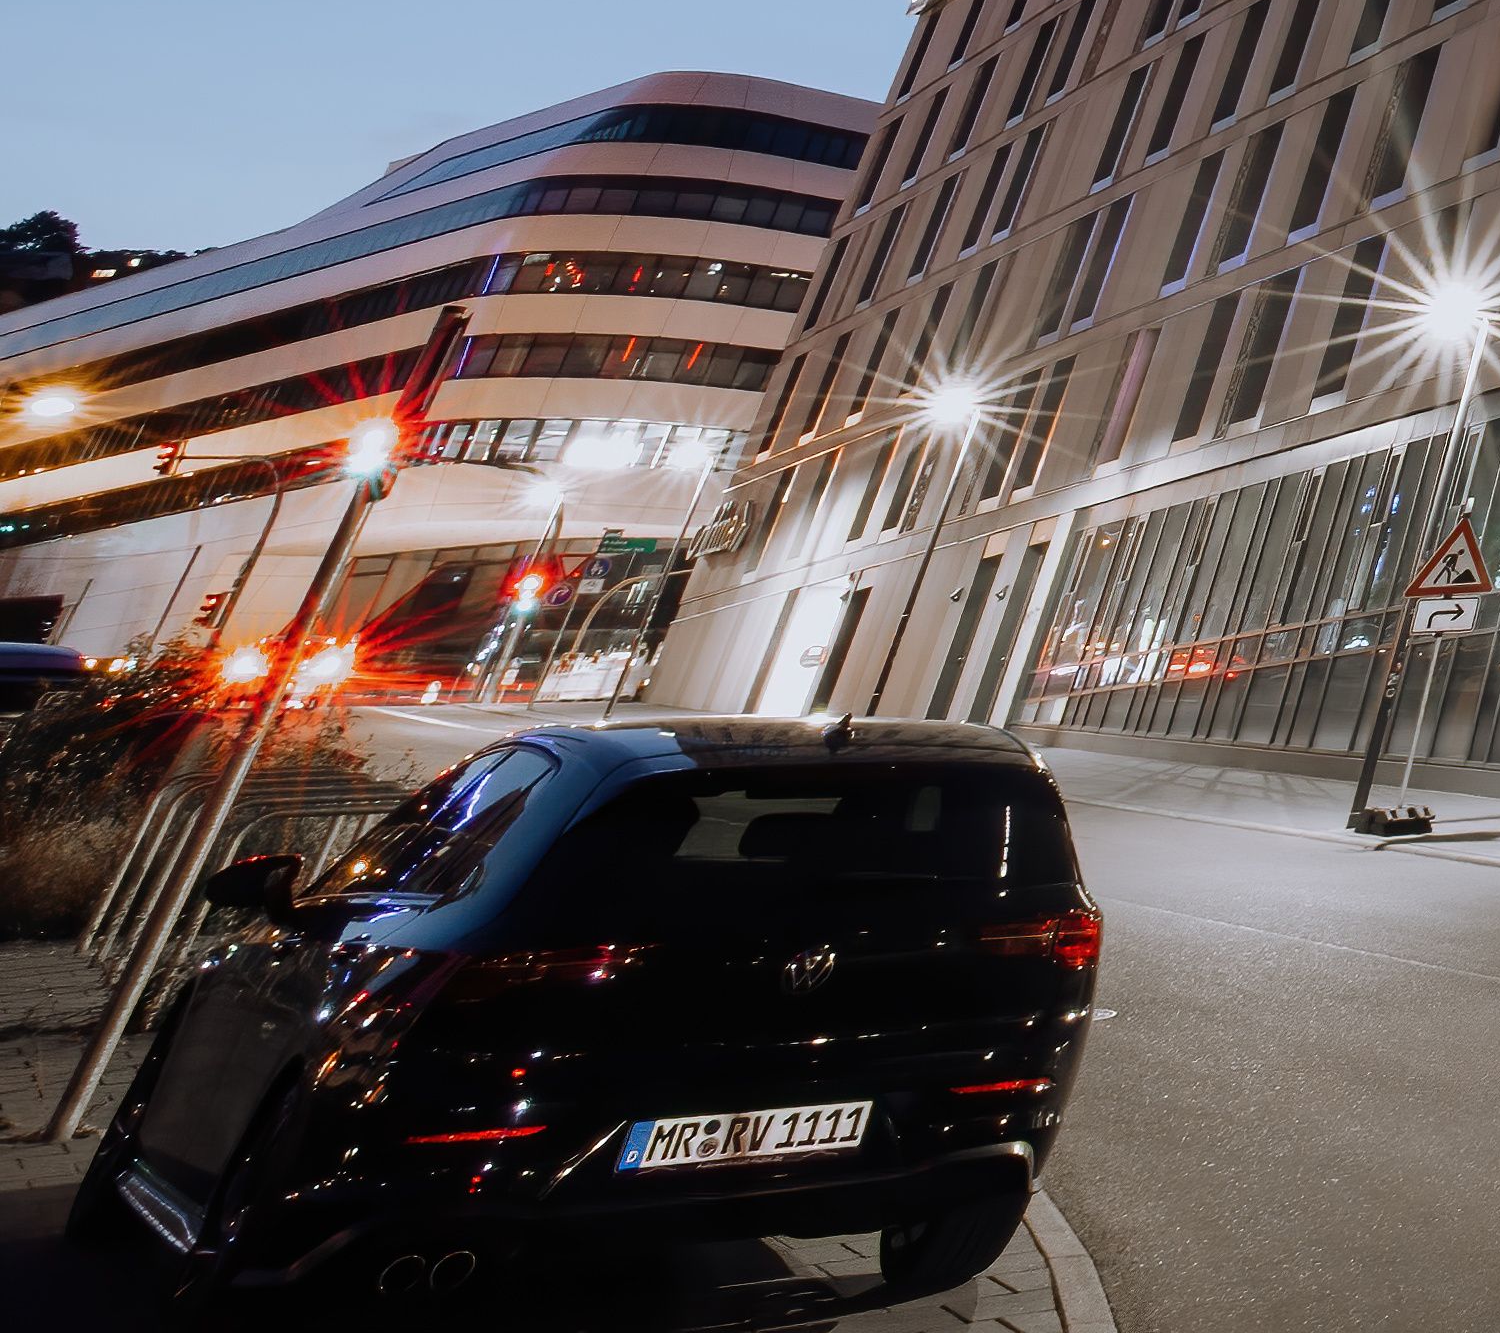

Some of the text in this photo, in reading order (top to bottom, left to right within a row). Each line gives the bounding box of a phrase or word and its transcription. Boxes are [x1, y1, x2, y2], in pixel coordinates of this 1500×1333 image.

[645, 1123, 700, 1161] MR
[721, 1115, 775, 1155] RV
[774, 1107, 863, 1148] 1111
